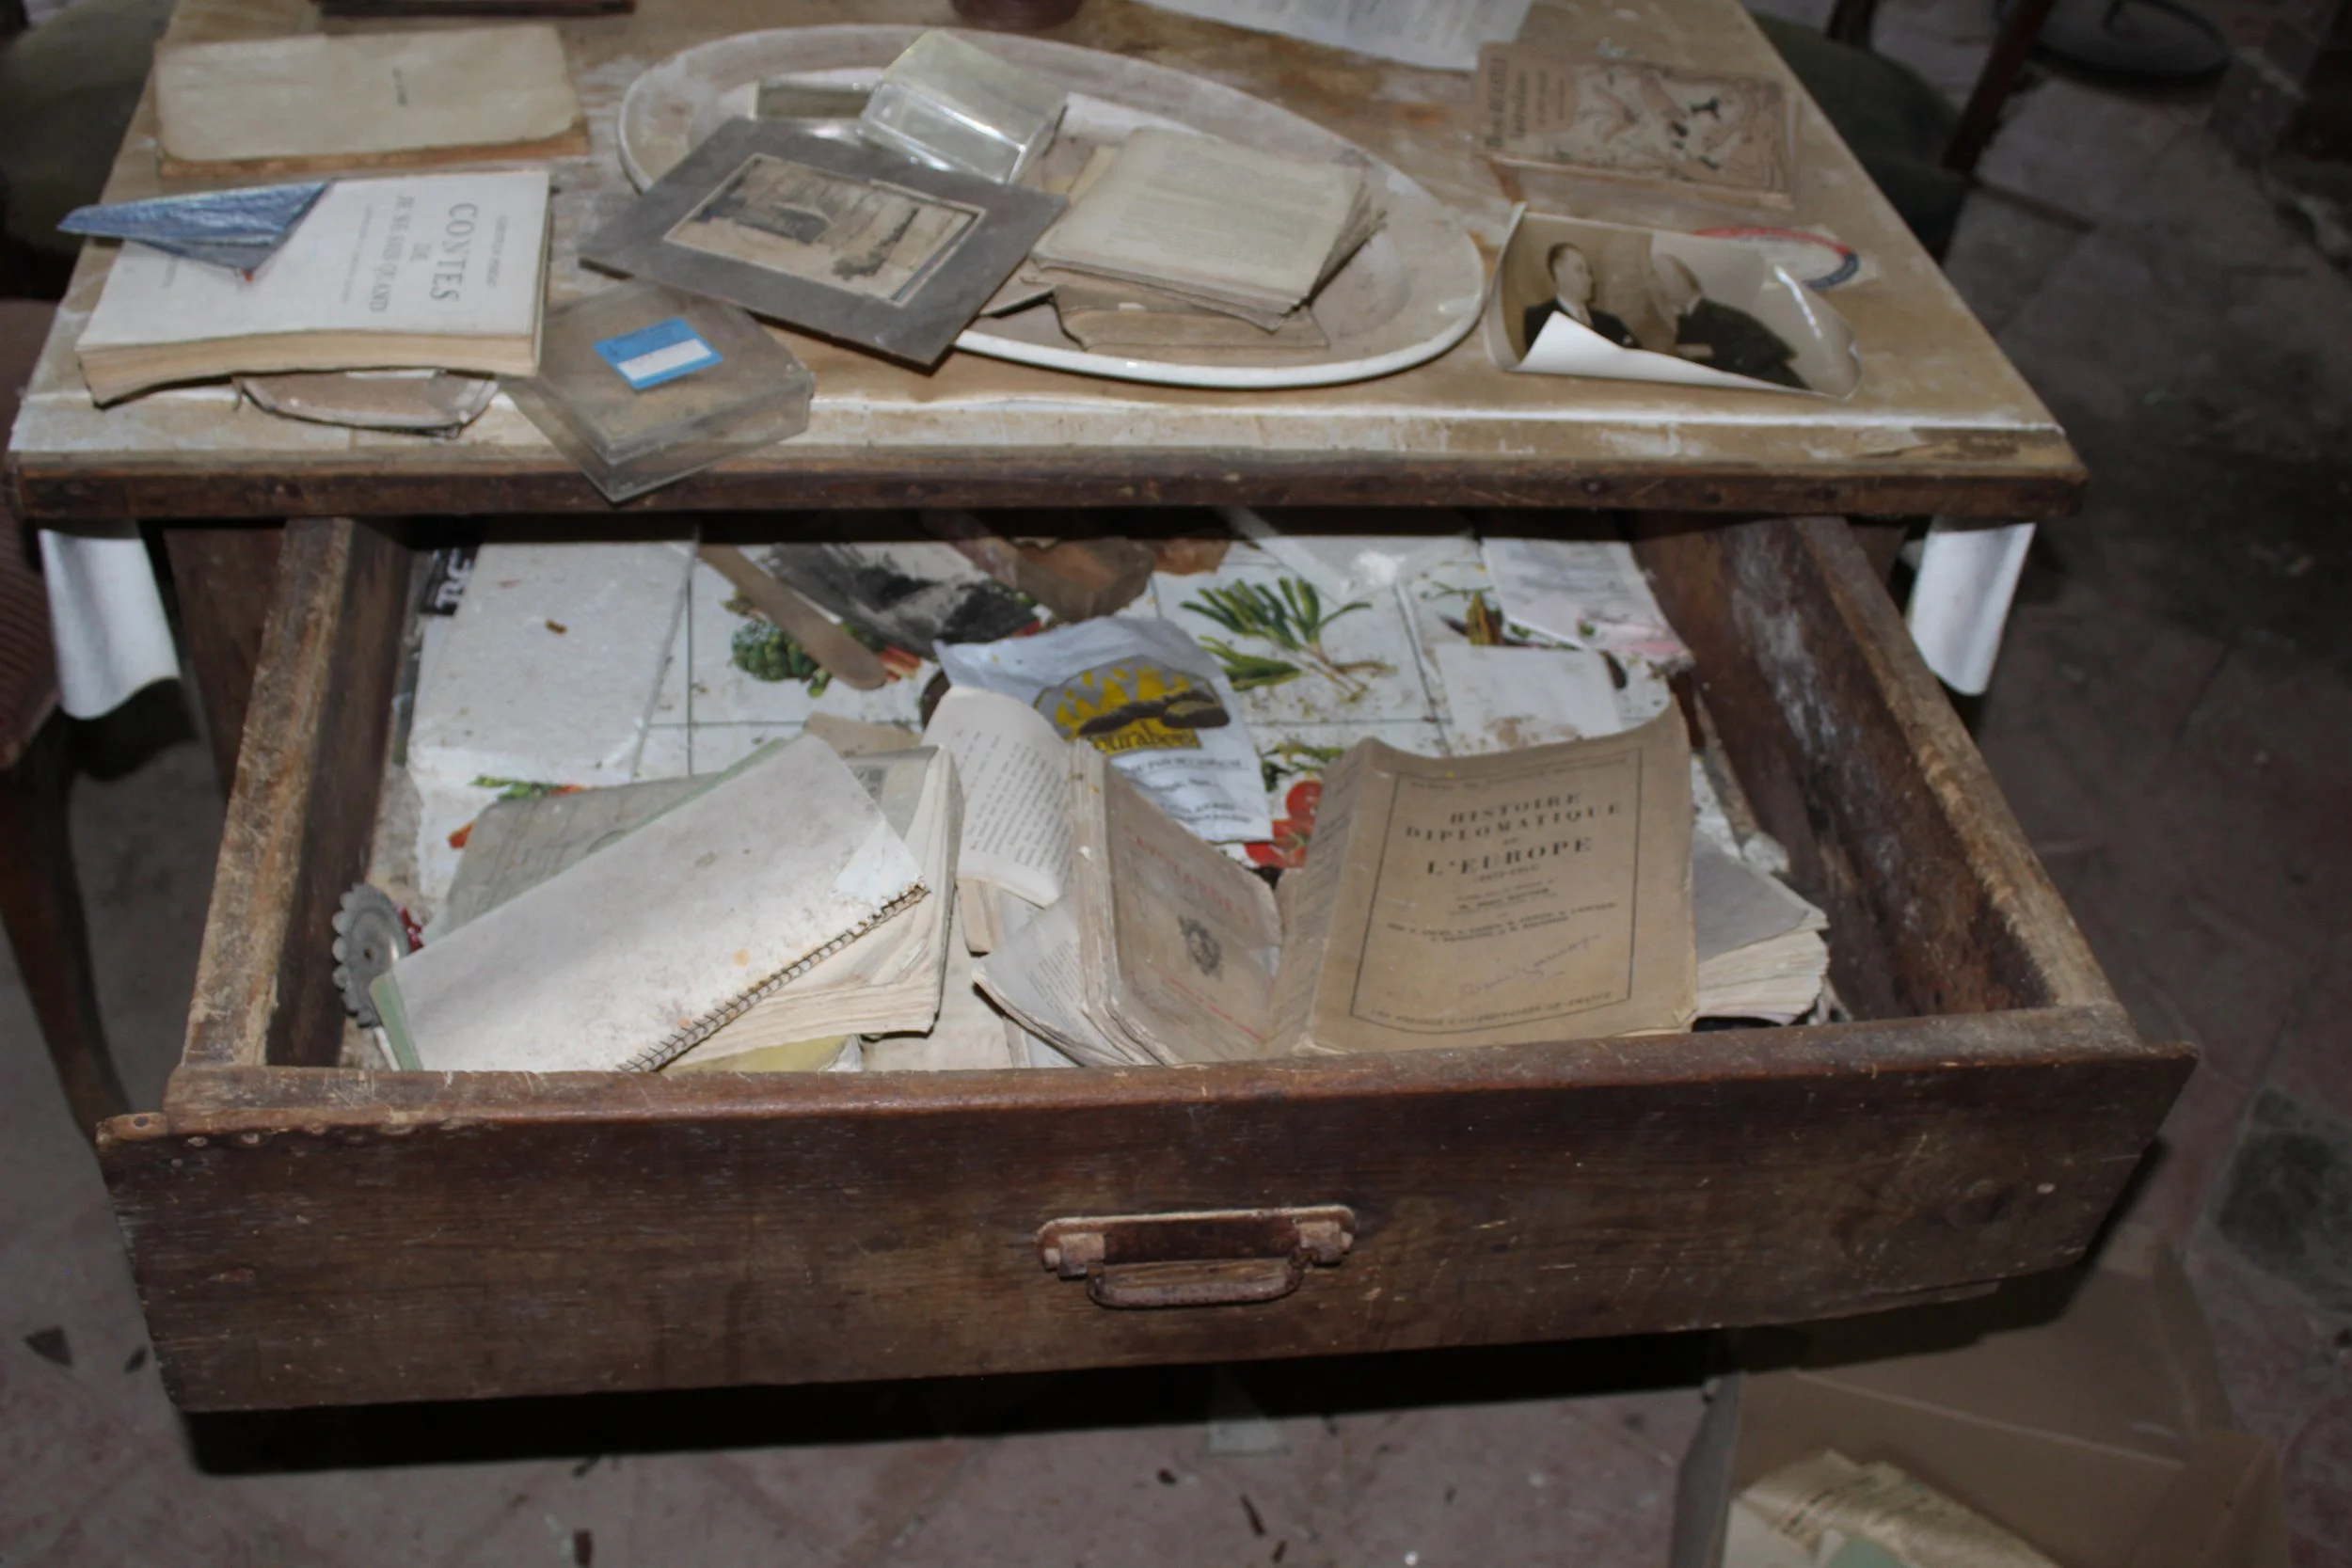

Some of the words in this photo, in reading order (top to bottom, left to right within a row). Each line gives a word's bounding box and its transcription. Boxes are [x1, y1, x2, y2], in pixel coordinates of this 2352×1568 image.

[429, 202, 479, 302] CONTES
[1406, 802, 1622, 842] DIPLOMATIQUE
[1450, 793, 1581, 825] HISTOIRE
[1427, 837, 1592, 875] L'EUROPE
